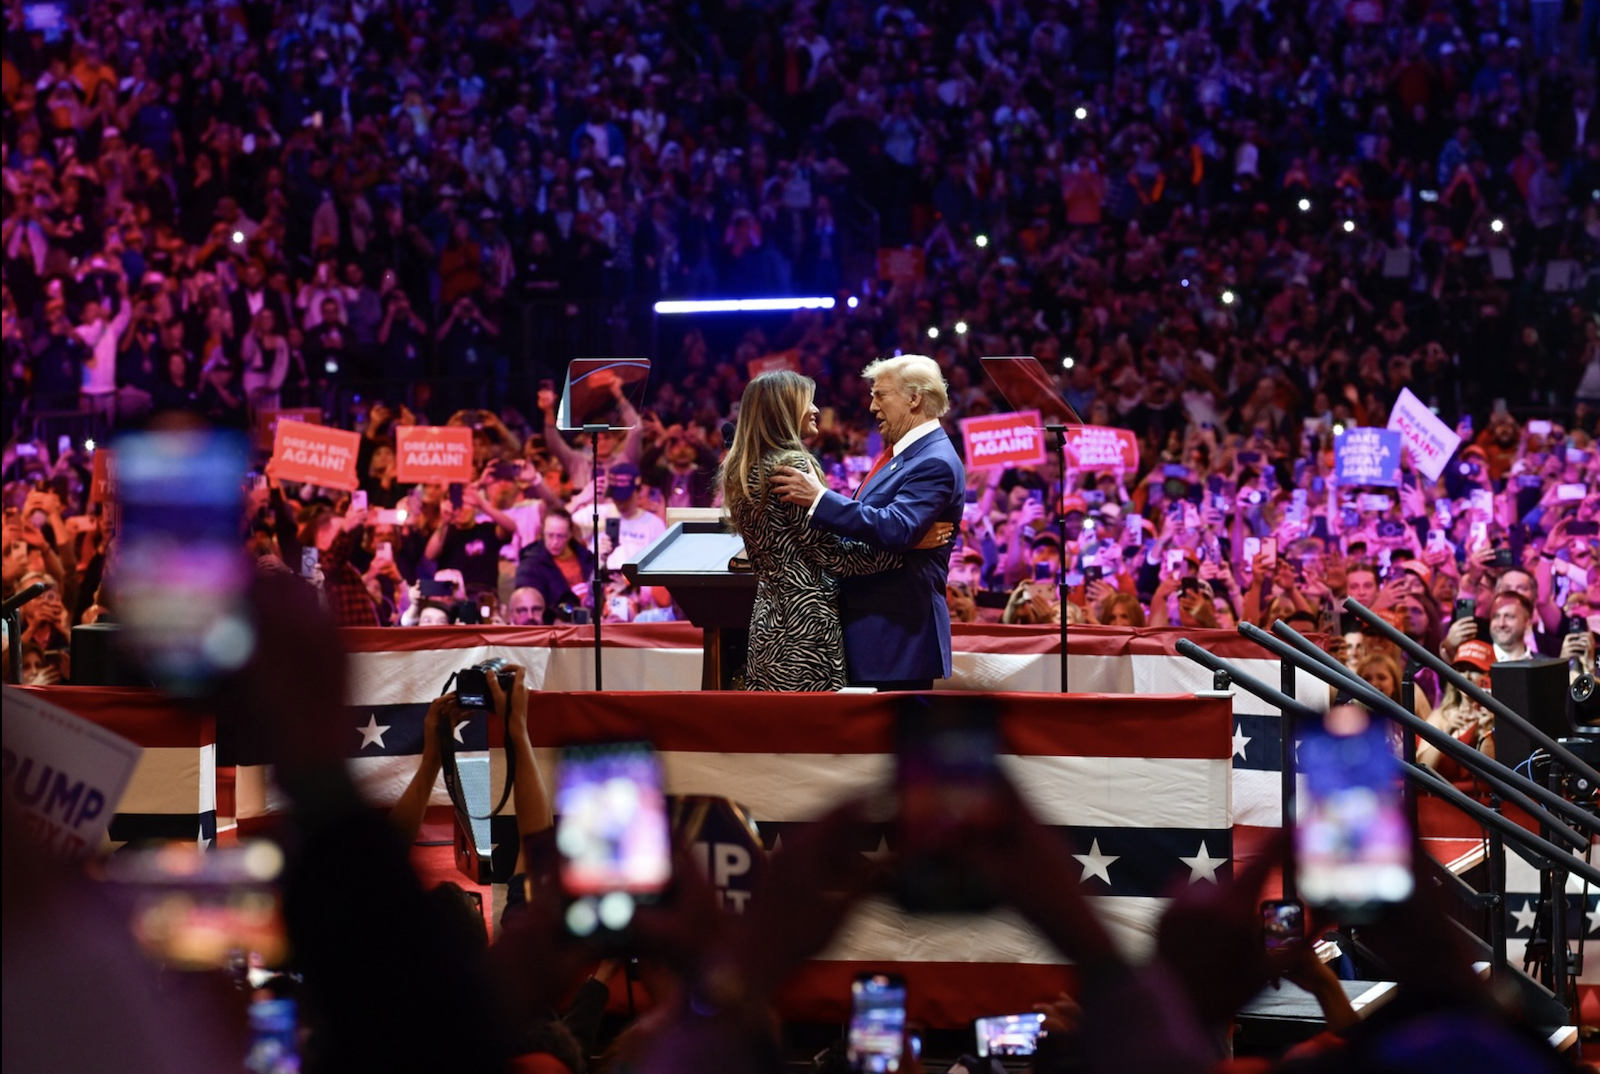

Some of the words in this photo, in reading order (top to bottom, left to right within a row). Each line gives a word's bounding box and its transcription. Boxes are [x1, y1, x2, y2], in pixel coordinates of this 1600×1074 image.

[970, 428, 1012, 443] DREAM
[1346, 433, 1380, 444] MAKE
[1397, 418, 1439, 458] AGAIN!
[282, 436, 327, 454] DREAM
[404, 441, 445, 452] DREAM
[973, 436, 1035, 457] AGAIN!
[1339, 446, 1390, 458] AMERICA
[281, 448, 345, 471] AGAIN!
[406, 452, 464, 467] AGAIN!
[1342, 456, 1381, 467] GREAT
